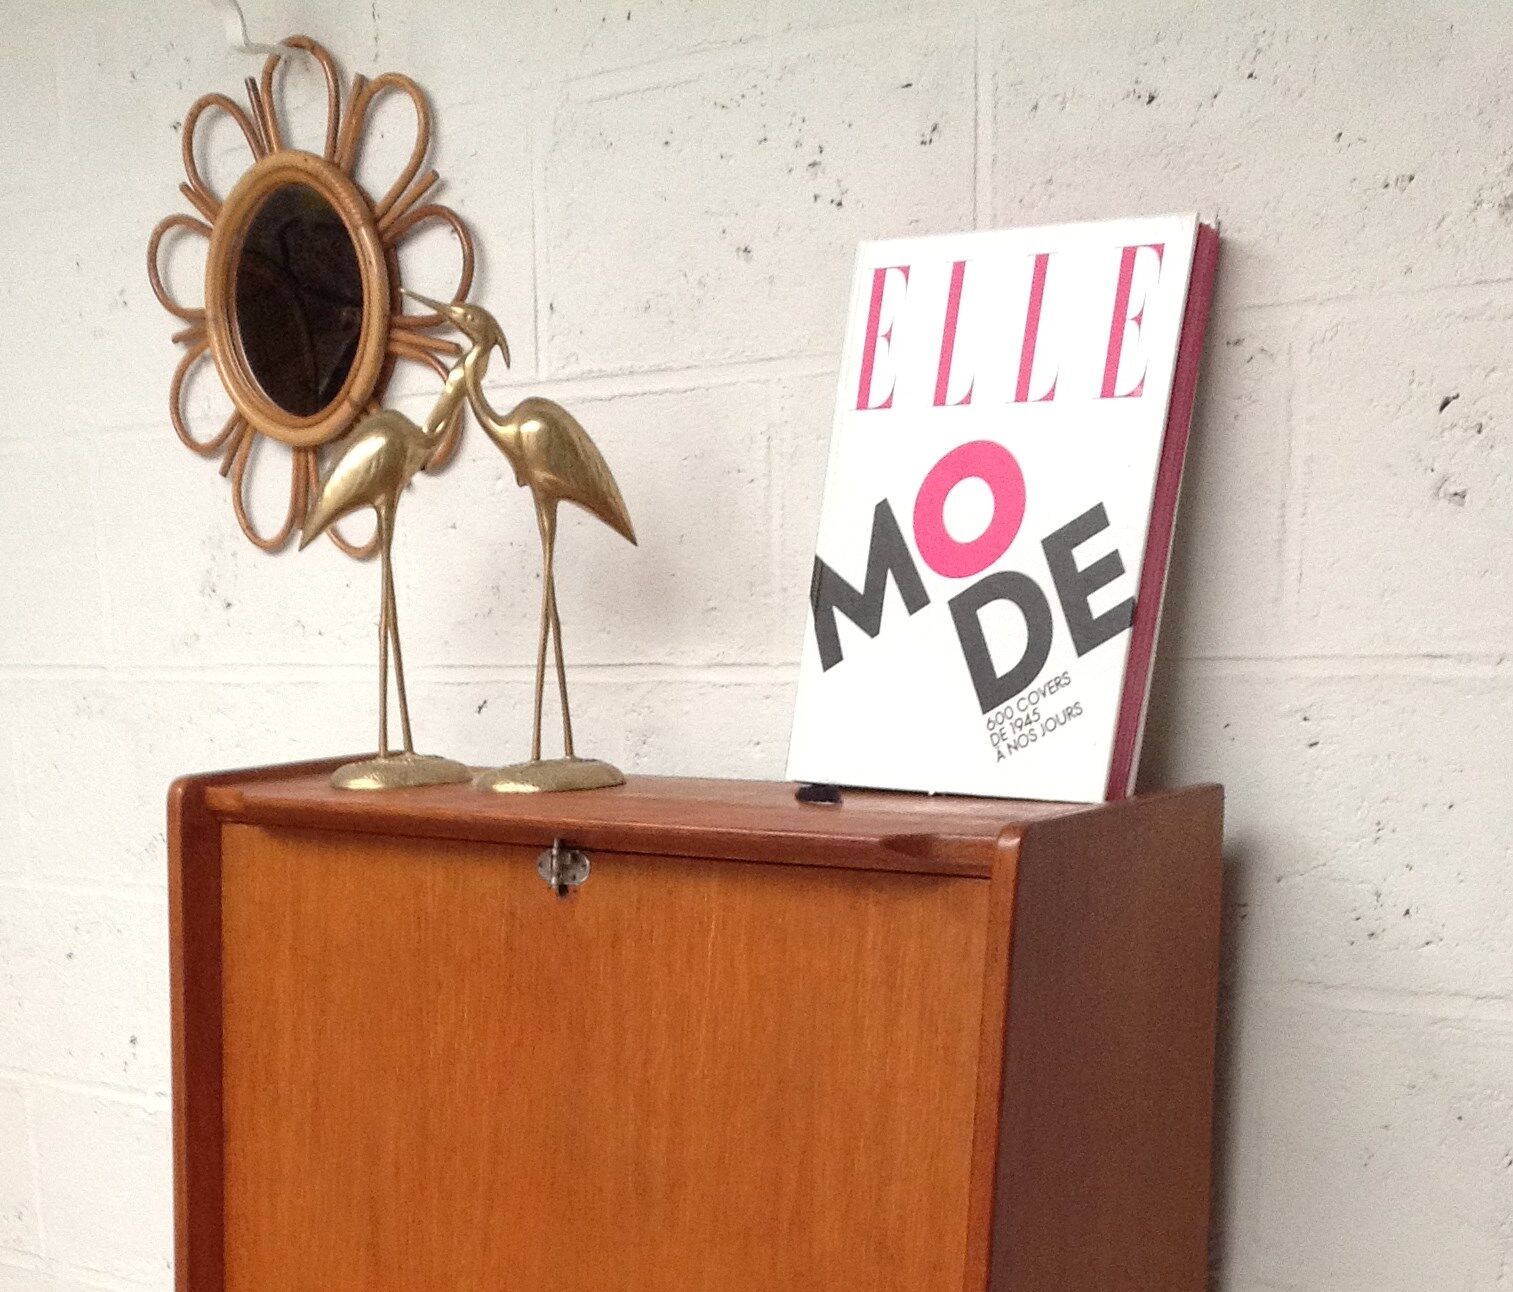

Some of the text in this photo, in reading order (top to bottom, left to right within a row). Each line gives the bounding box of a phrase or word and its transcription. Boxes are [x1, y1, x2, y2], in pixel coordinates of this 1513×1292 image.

[849, 243, 1165, 412] ELLE
[809, 439, 1137, 715] MODE
[986, 671, 1071, 731] 600 COVERS
[989, 707, 1041, 747] DE 1945
[1006, 728, 1038, 756] NOS
[1040, 701, 1083, 737] JOURS
